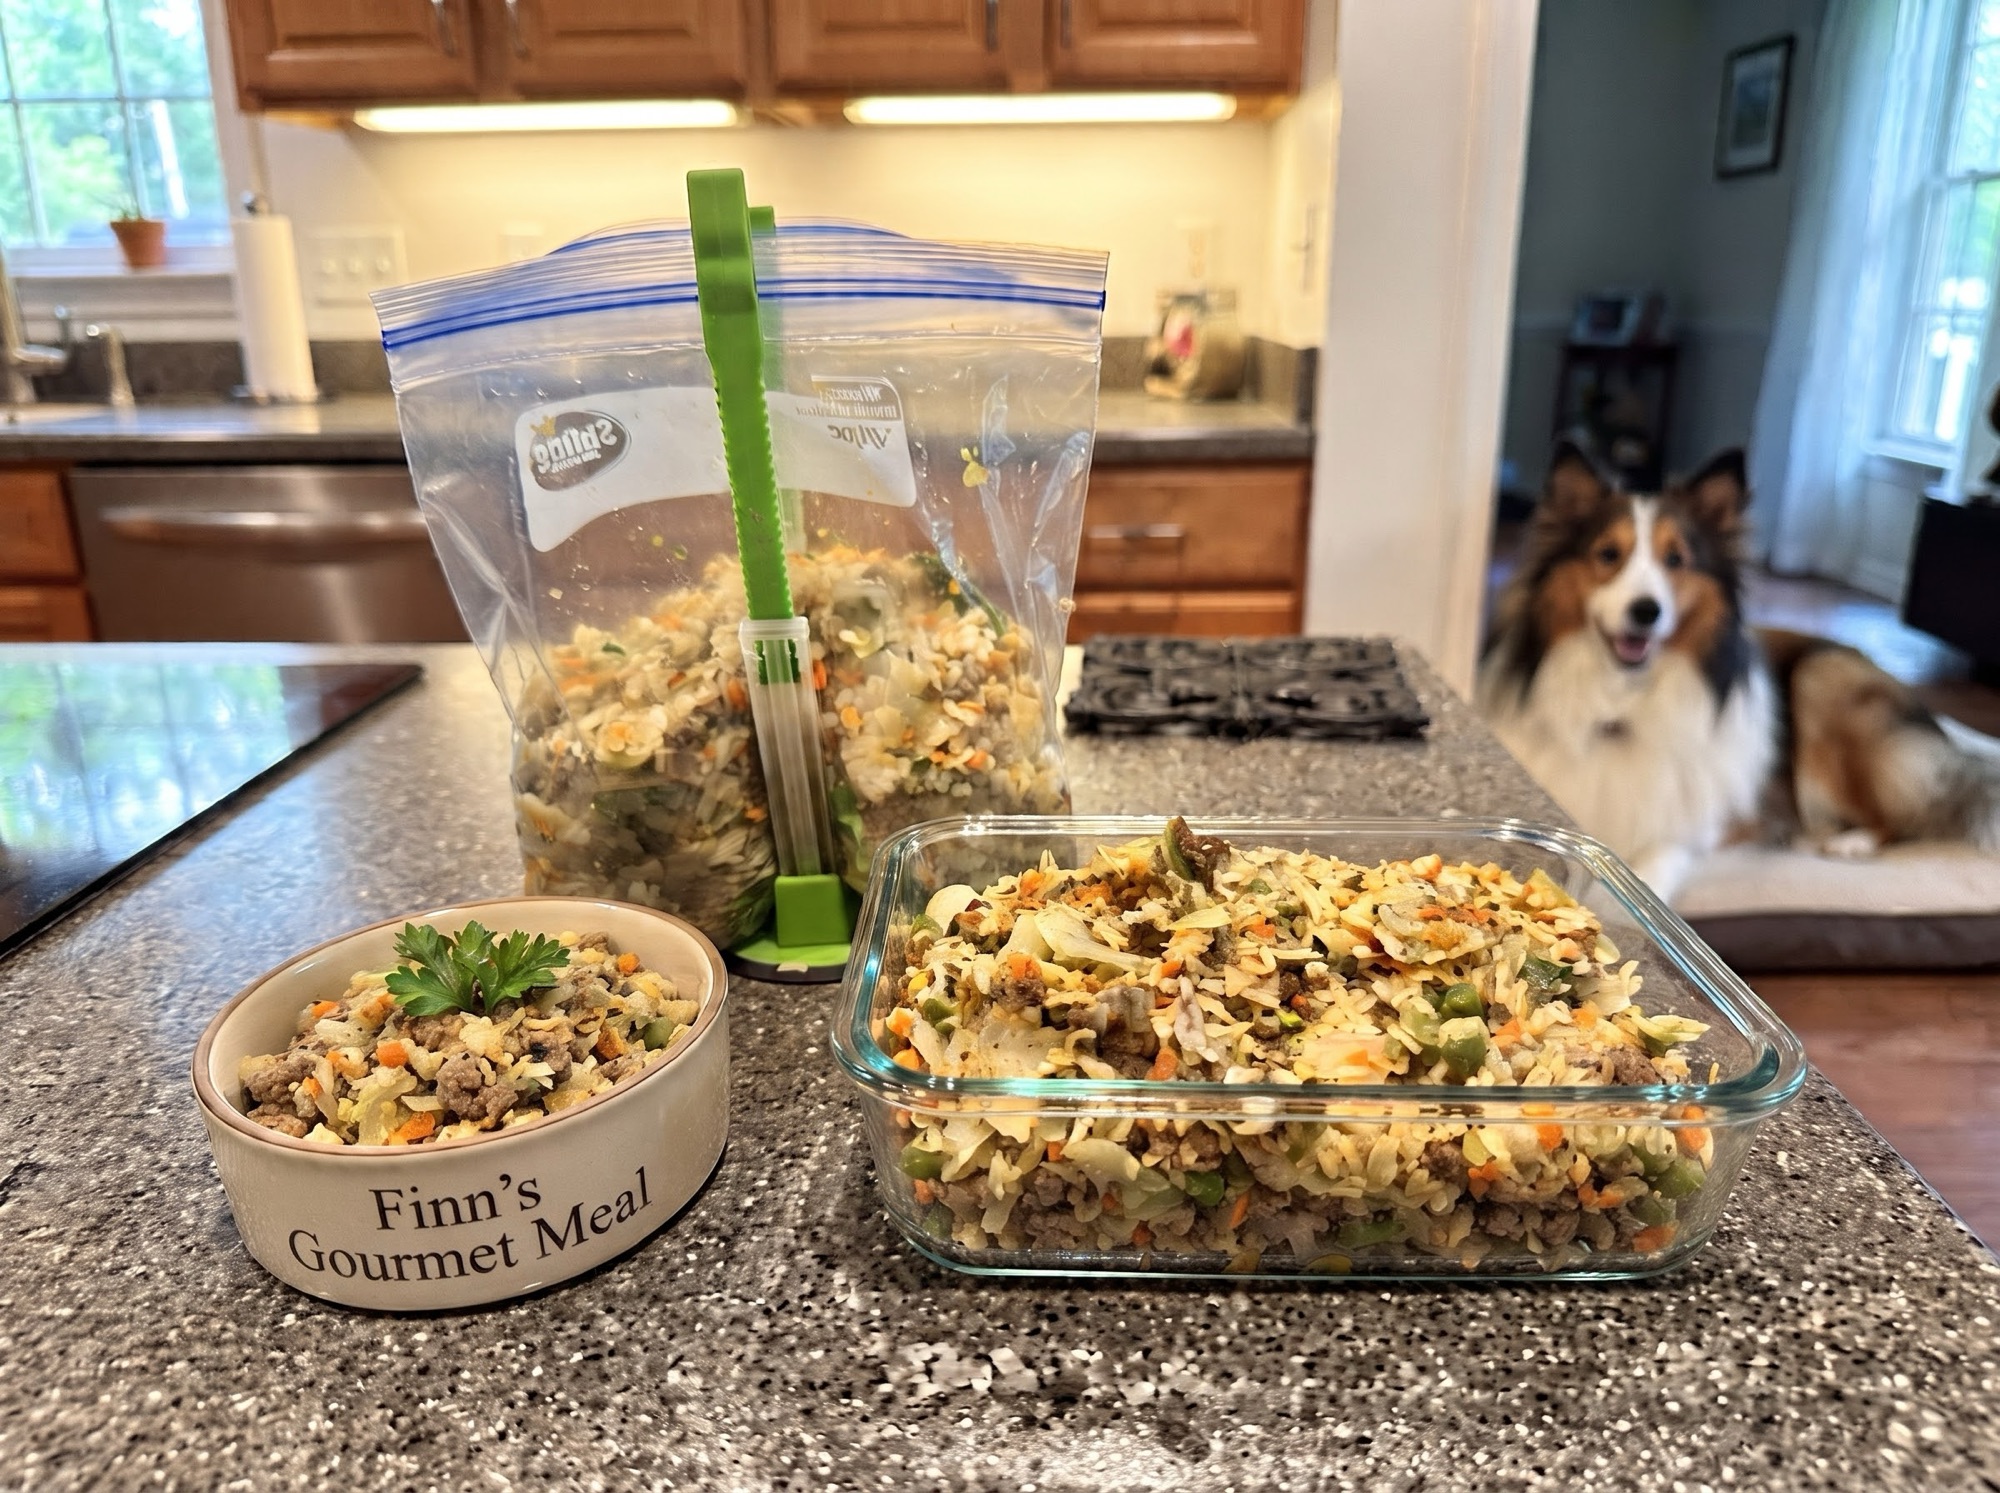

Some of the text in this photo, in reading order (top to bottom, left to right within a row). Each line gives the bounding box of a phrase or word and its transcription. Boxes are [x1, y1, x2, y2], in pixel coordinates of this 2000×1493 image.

[288, 1165, 652, 1282] Gourmet Meal
[368, 1173, 542, 1231] Finn’s
